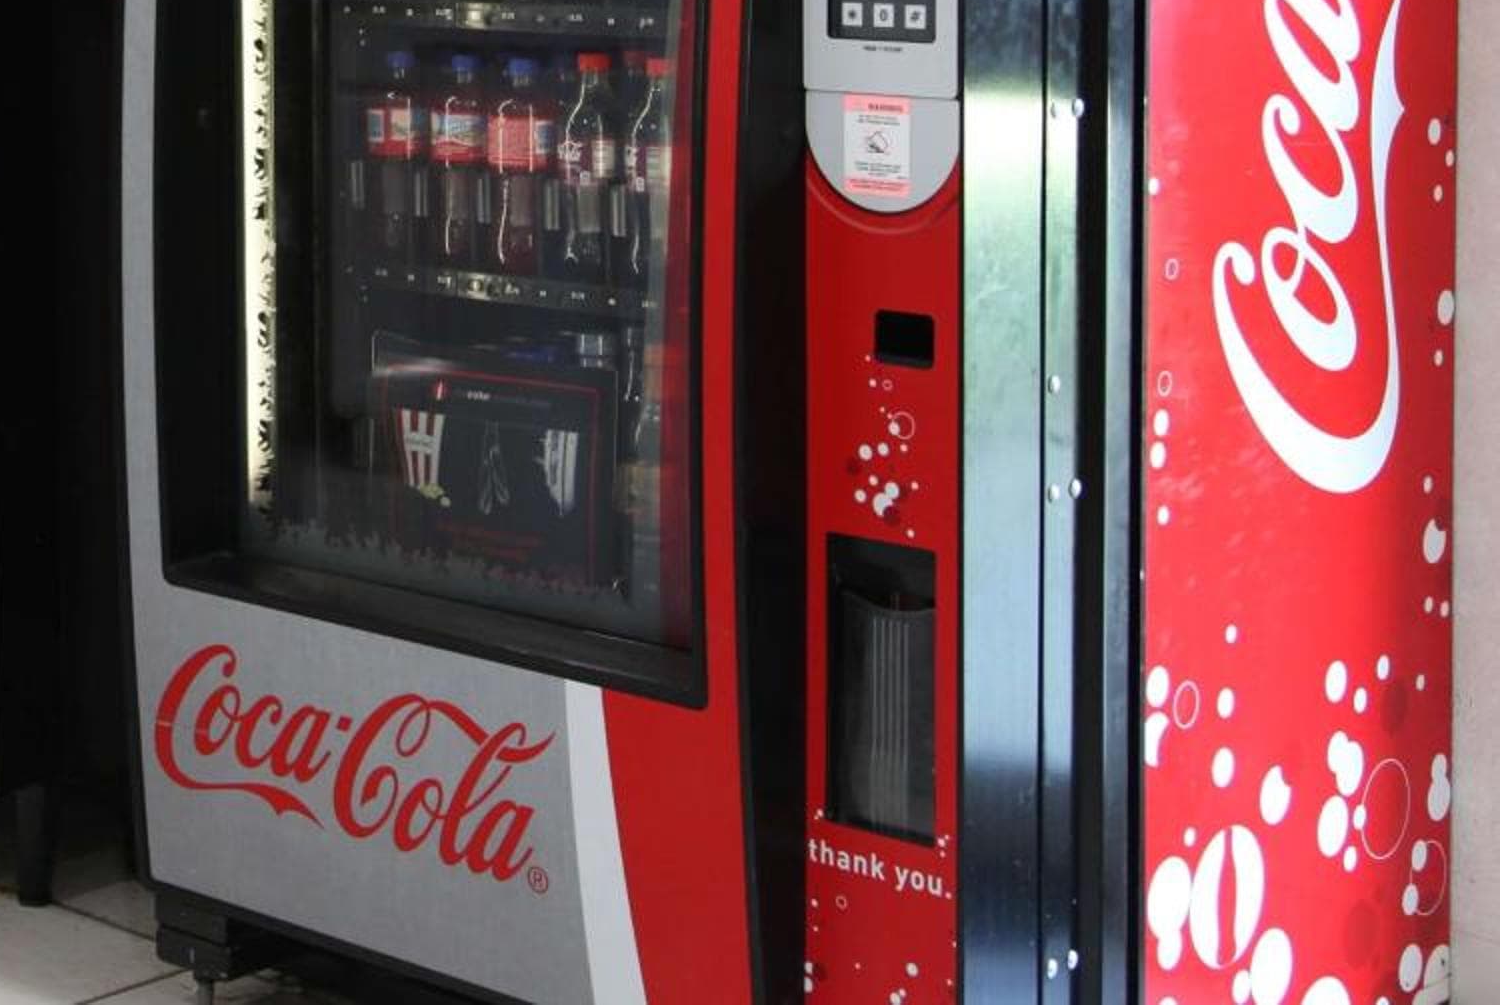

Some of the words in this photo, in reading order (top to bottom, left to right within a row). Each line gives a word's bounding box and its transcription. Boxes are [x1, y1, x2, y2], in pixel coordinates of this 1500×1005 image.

[155, 644, 555, 882] Coca-Cola
[807, 839, 885, 881] thank
[895, 866, 952, 900] you.
